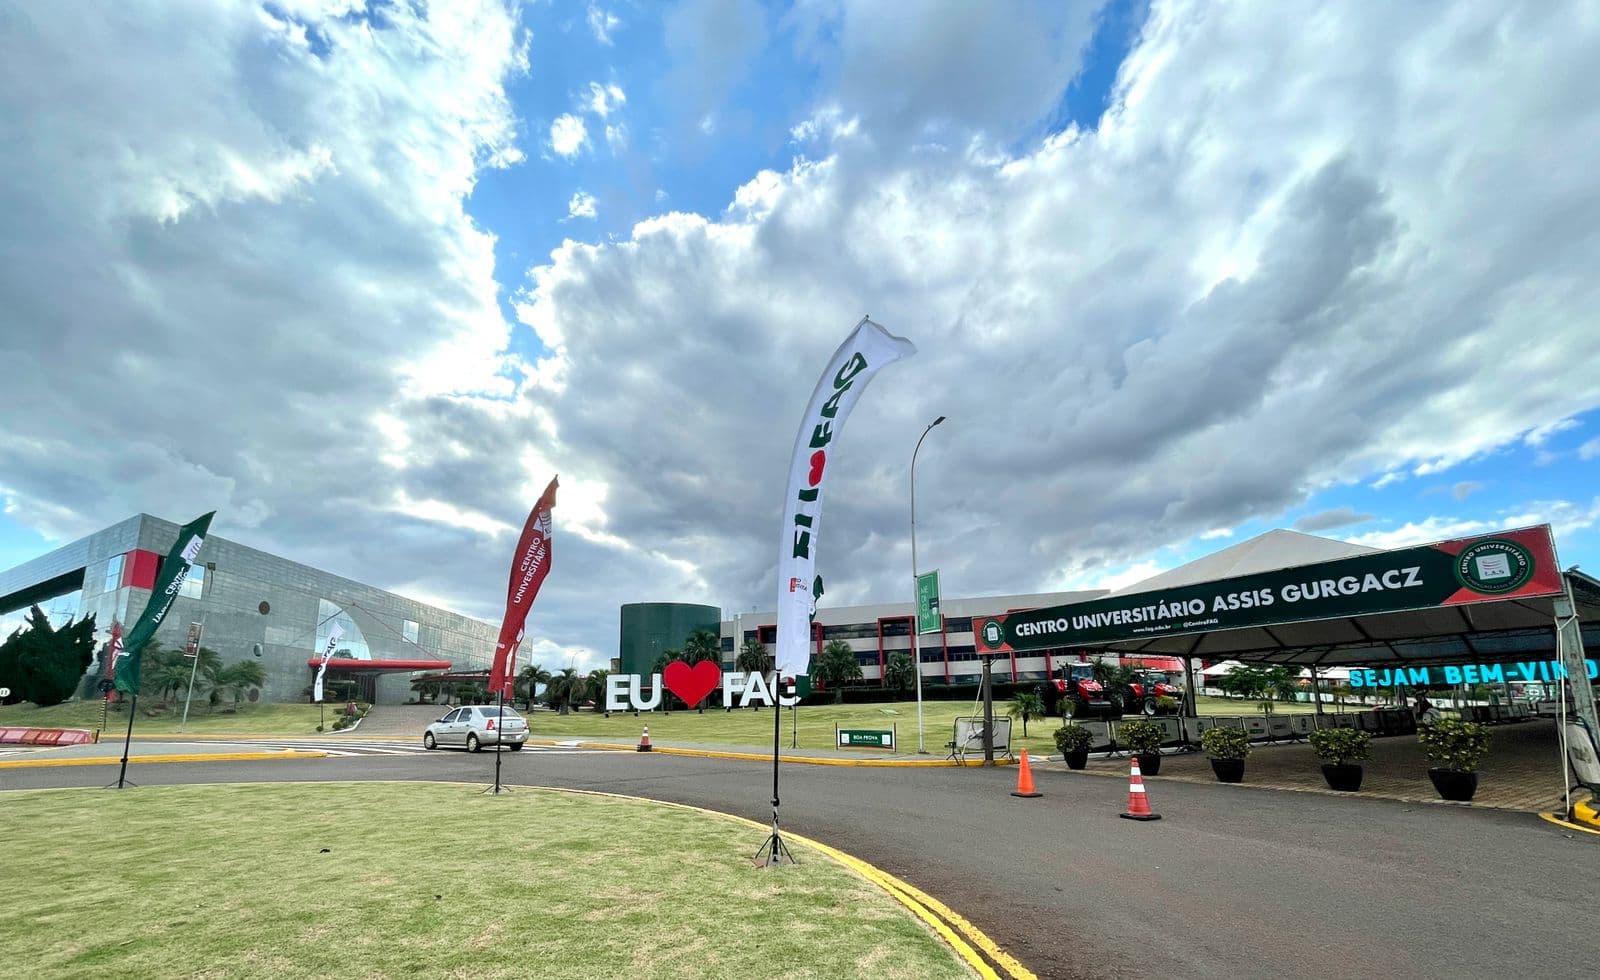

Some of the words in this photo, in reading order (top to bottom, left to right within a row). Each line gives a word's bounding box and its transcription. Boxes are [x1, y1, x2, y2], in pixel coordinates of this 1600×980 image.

[808, 351, 868, 449] FAG
[513, 543, 547, 604] UNIVERSITÁRI
[520, 537, 542, 572] CENTRO
[1015, 617, 1068, 637] CENTRO
[1072, 599, 1206, 630] UNIVERSITÁRIO
[1212, 588, 1274, 613] ASSIS
[1281, 566, 1424, 603] GURGACZ
[606, 673, 662, 711] EU
[1349, 667, 1430, 688] SEJAM
